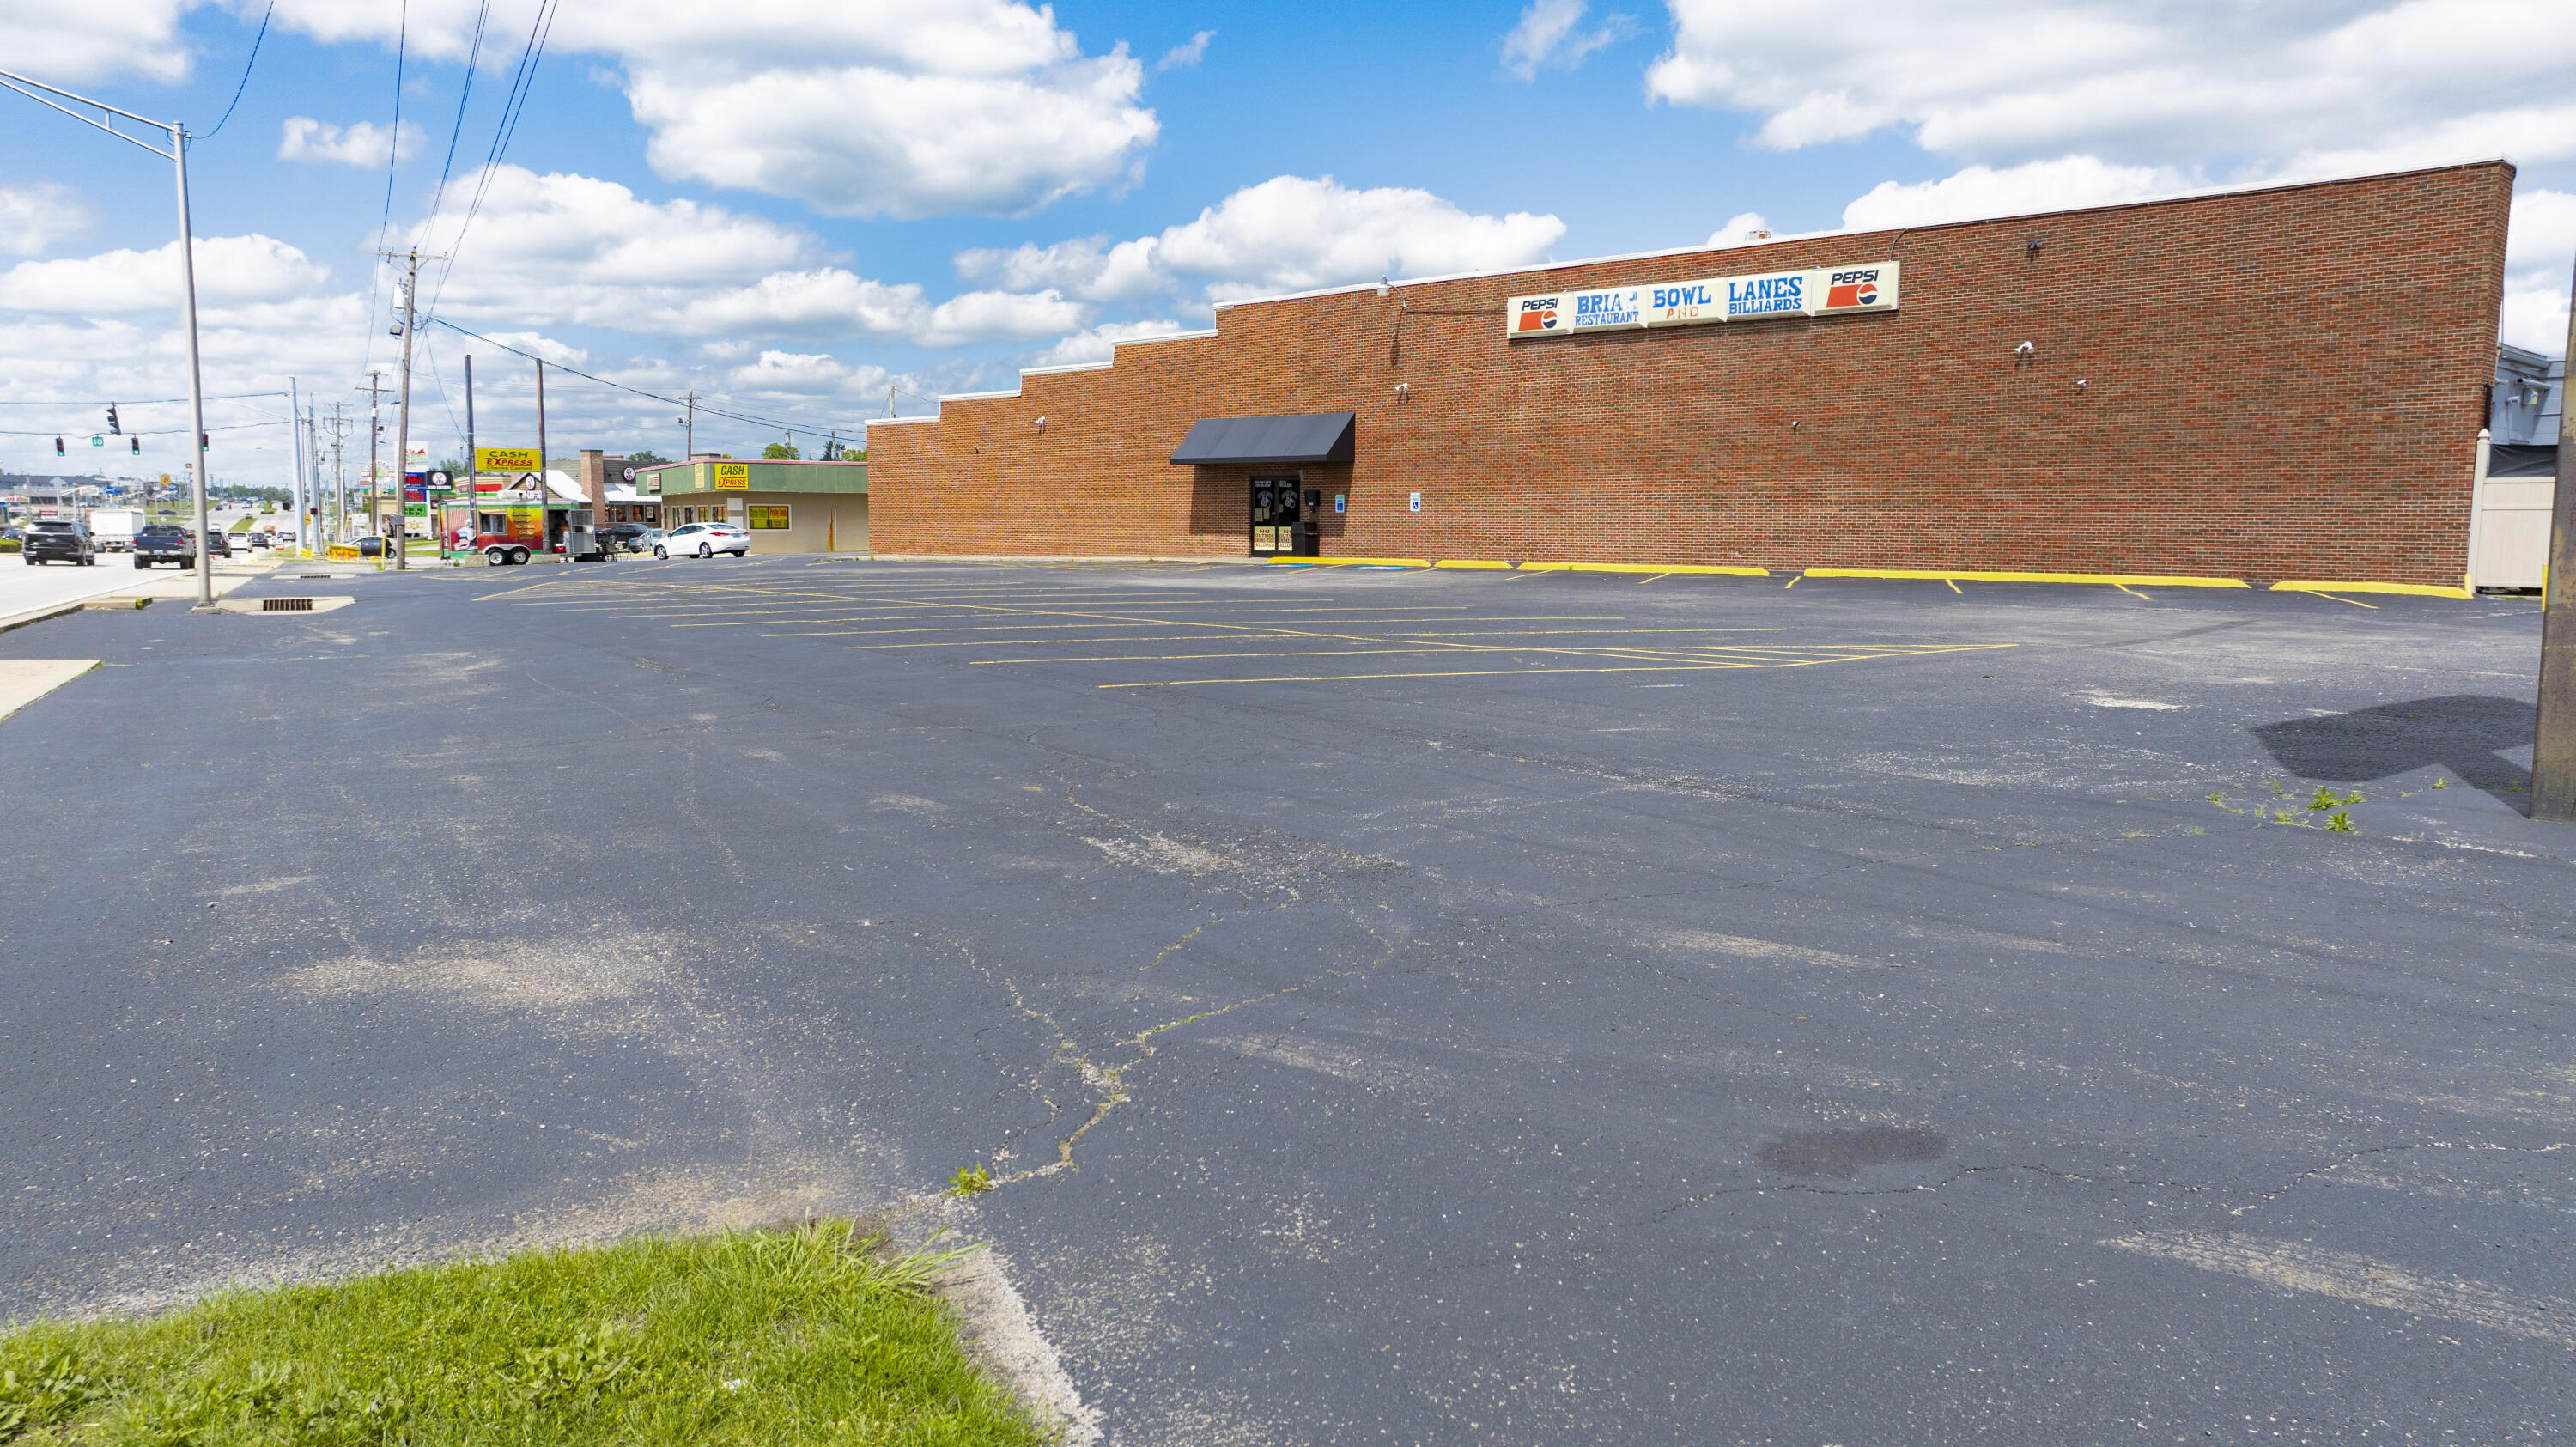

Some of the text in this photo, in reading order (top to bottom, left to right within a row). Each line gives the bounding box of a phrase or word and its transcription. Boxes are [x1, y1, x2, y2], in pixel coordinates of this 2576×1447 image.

[1831, 269, 1880, 285] PEPSI
[1652, 285, 1712, 308] BOWL
[1728, 276, 1803, 302] LANES
[1522, 298, 1558, 311] PEPSI
[1575, 297, 1802, 326] RESTAURANT AND BILLIARDS
[486, 458, 533, 466] EXPRESS
[720, 465, 744, 475] CASH
[718, 477, 746, 487] EXPRESS
